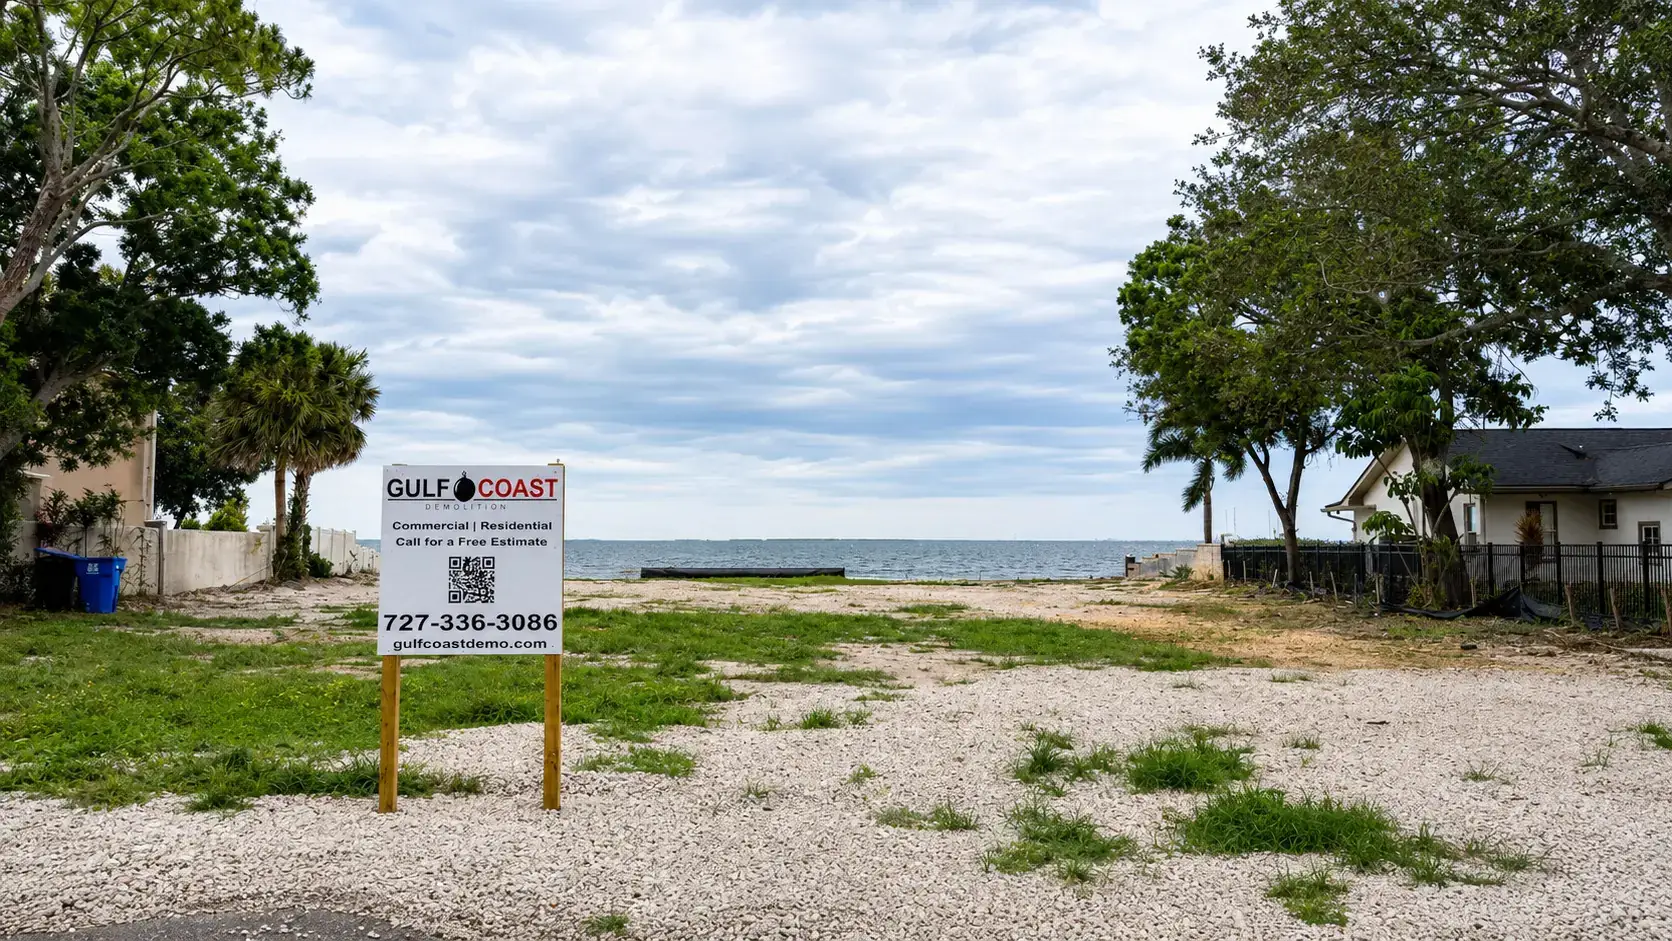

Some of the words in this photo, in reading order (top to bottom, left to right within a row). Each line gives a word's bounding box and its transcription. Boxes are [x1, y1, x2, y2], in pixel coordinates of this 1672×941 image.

[387, 478, 450, 498] GULF
[478, 478, 558, 498] COAST
[425, 503, 507, 511] DEMOLITION
[392, 521, 469, 531] Commercial
[480, 521, 552, 531] Residential
[396, 537, 421, 547] Call
[425, 537, 443, 547] for
[447, 539, 454, 547] a
[458, 537, 487, 547] Free
[491, 537, 548, 547] Estimate
[384, 613, 558, 632] 727-336-3086
[393, 639, 547, 652] gulfcoastdemo.com
